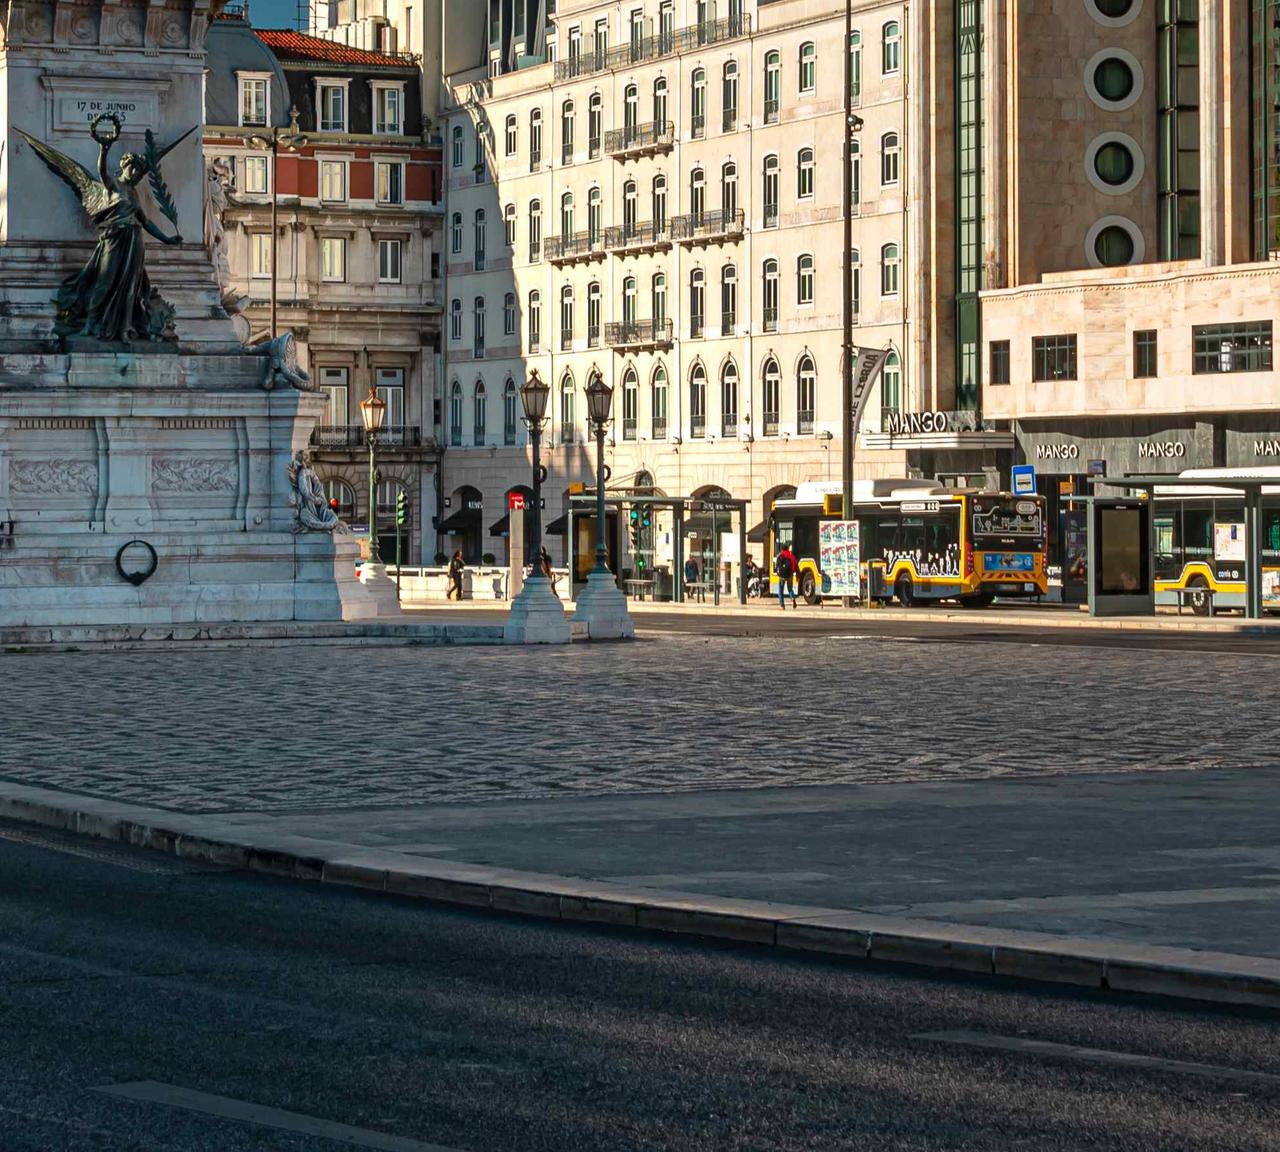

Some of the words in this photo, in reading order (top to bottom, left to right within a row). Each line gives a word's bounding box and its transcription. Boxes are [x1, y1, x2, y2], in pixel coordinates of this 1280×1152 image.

[77, 101, 86, 112] 17
[90, 102, 102, 110] DE
[105, 102, 136, 111] JUNHO
[887, 411, 947, 433] MANGO
[1036, 444, 1079, 459] MANGO
[1138, 442, 1185, 457] MANGO
